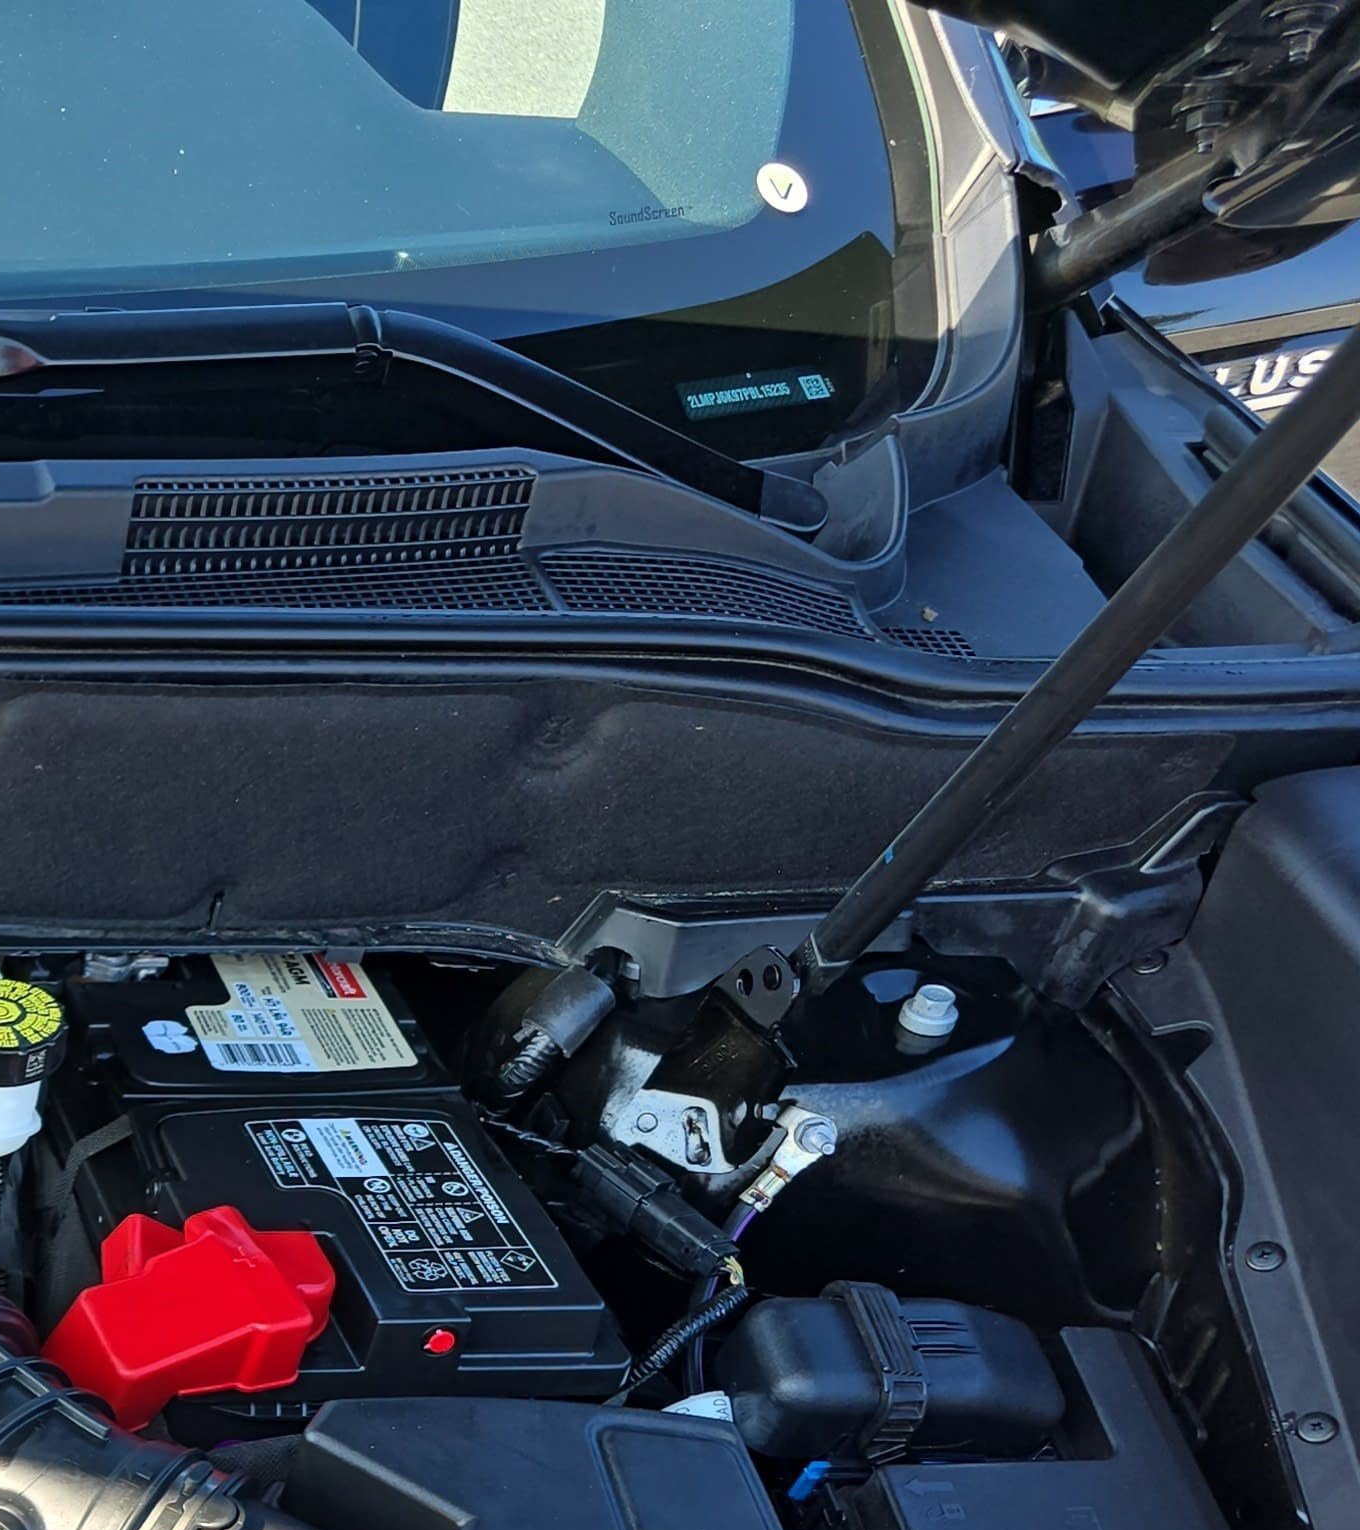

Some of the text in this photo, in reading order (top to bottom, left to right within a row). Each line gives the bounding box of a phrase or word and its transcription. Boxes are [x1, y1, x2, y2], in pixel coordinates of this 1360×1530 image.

[608, 206, 685, 226] SoundScreen
[283, 960, 311, 985] AGM
[447, 1150, 510, 1223] DANGER/POISON
[390, 1228, 410, 1243] NOT
[402, 1229, 420, 1240] DO
